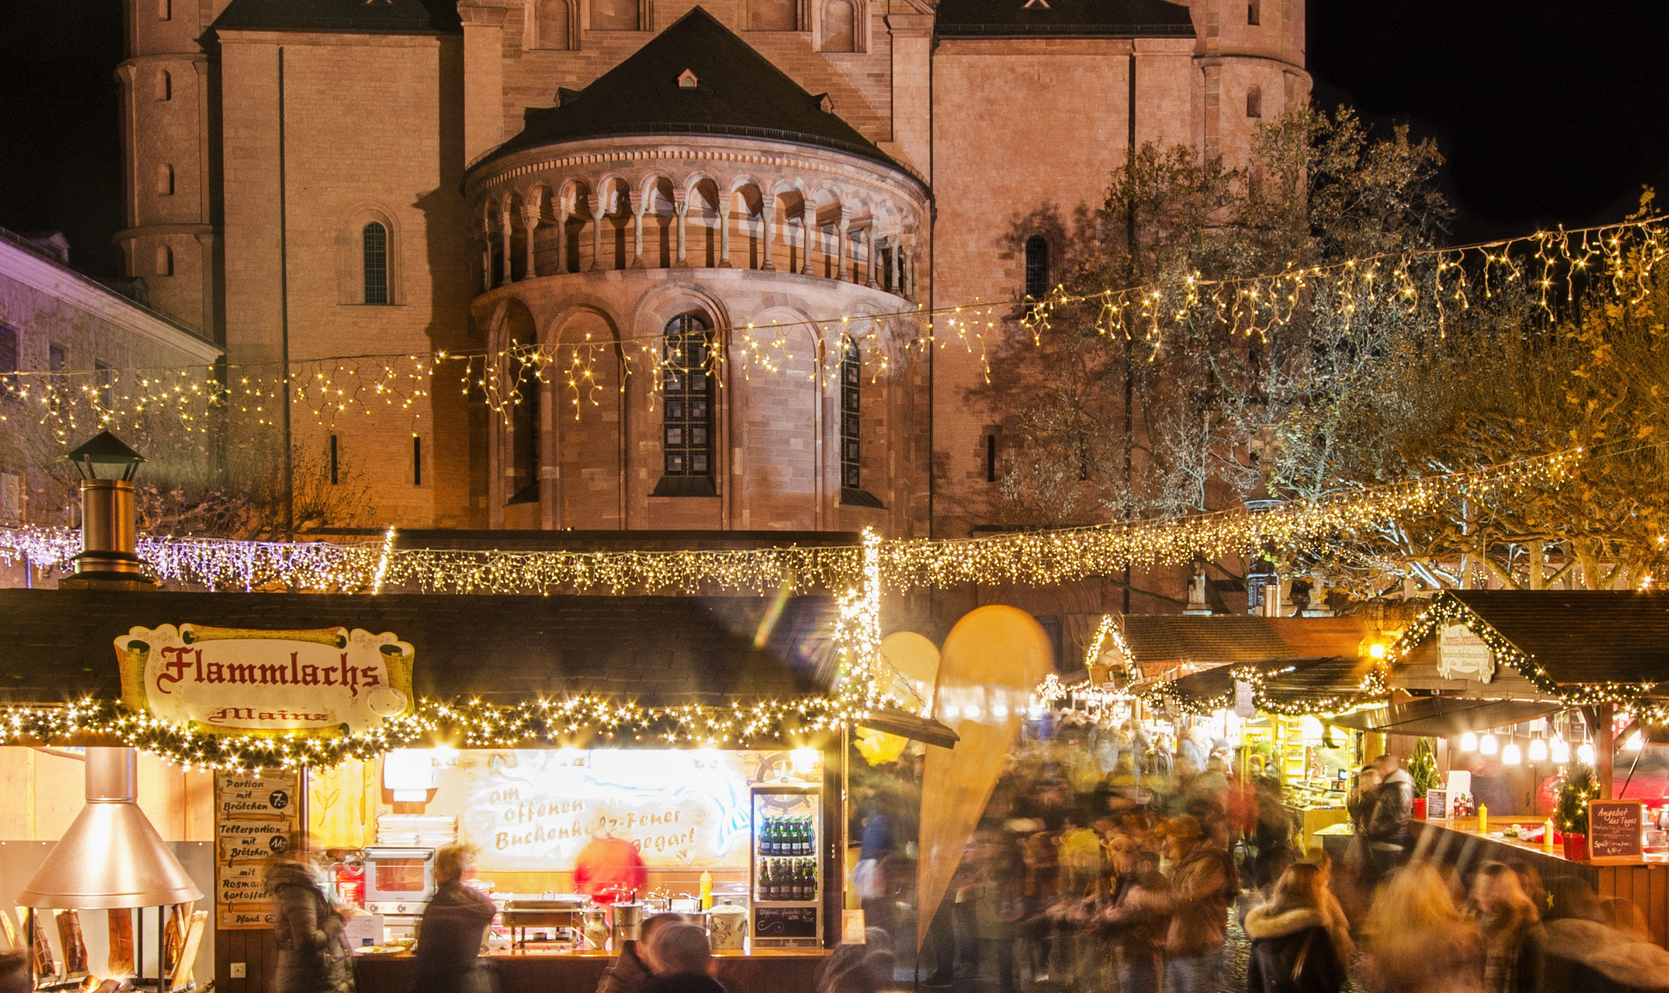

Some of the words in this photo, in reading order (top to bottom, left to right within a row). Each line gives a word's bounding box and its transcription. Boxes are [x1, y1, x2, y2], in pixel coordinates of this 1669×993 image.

[156, 646, 380, 697] Flammlachs
[207, 707, 329, 722] Mainz
[226, 779, 264, 788] Portion
[236, 791, 252, 799] mit
[489, 788, 520, 804] am
[223, 802, 268, 811] Brötchen
[505, 800, 583, 824] offenen
[1597, 807, 1629, 821] Angebot
[1621, 817, 1638, 827] Tages
[220, 825, 281, 834] Tellerportion
[242, 837, 256, 845] mit
[230, 848, 268, 857] Brötchen
[240, 868, 255, 876] mit
[236, 914, 260, 924] Pfand
